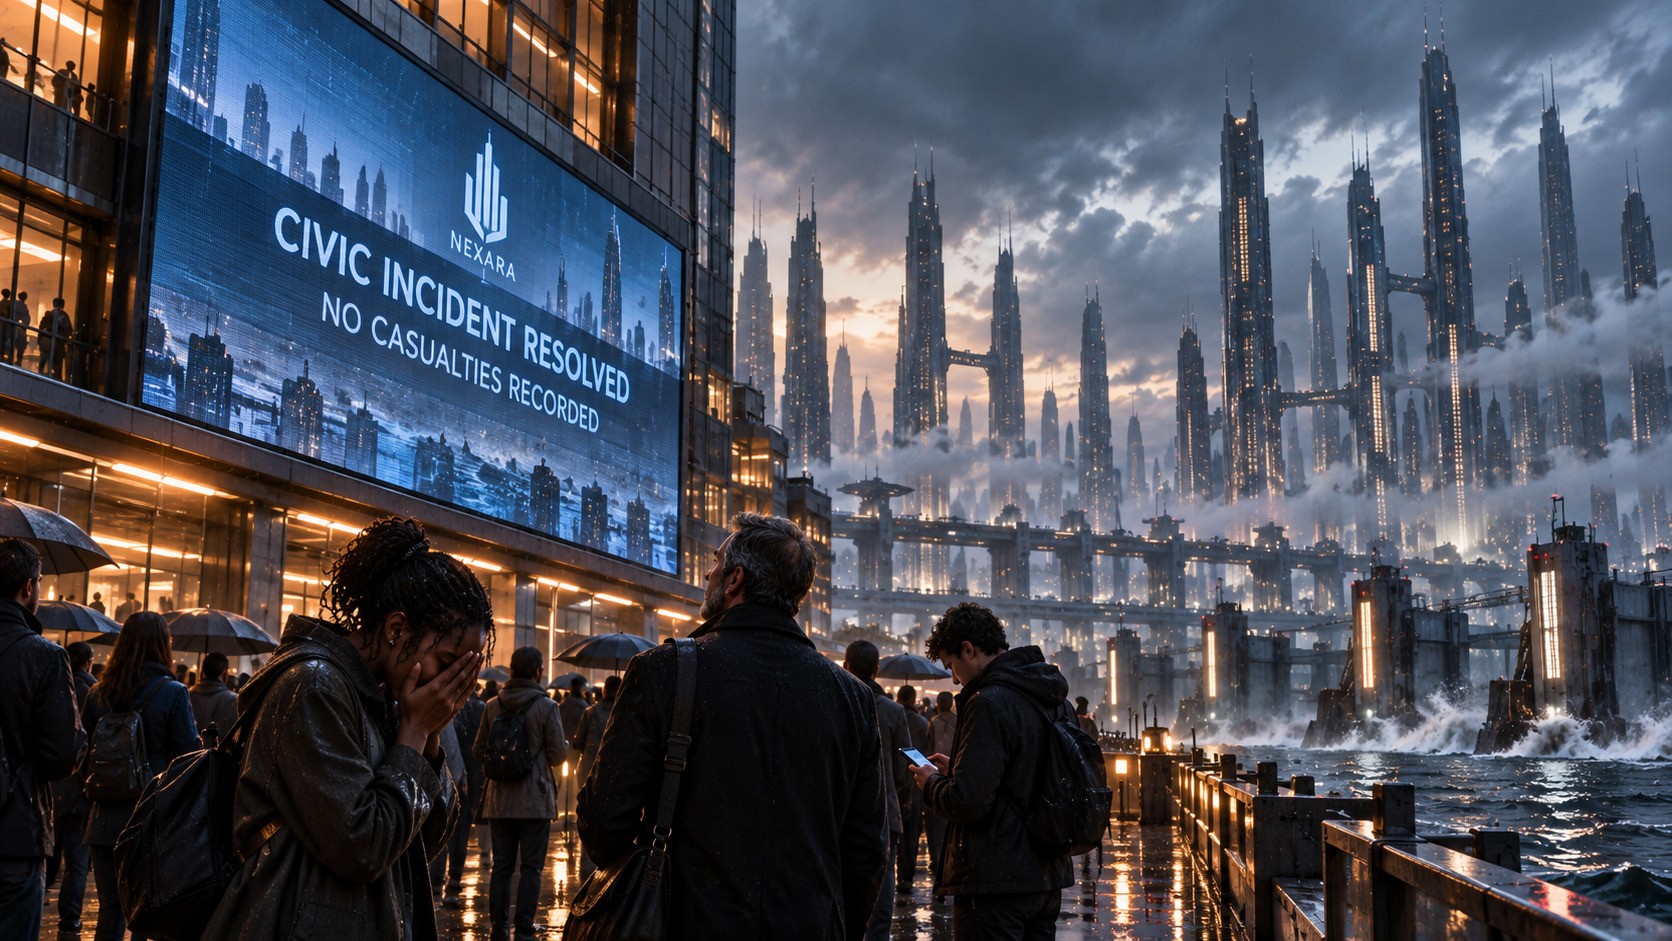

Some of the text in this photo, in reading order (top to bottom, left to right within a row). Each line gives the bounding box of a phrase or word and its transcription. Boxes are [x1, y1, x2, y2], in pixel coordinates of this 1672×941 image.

[274, 207, 630, 404] CIVIC INCIDENT RESOLVED
[450, 229, 516, 282] NEXARA
[321, 291, 599, 434] NO CASUALTIES RECORDED
